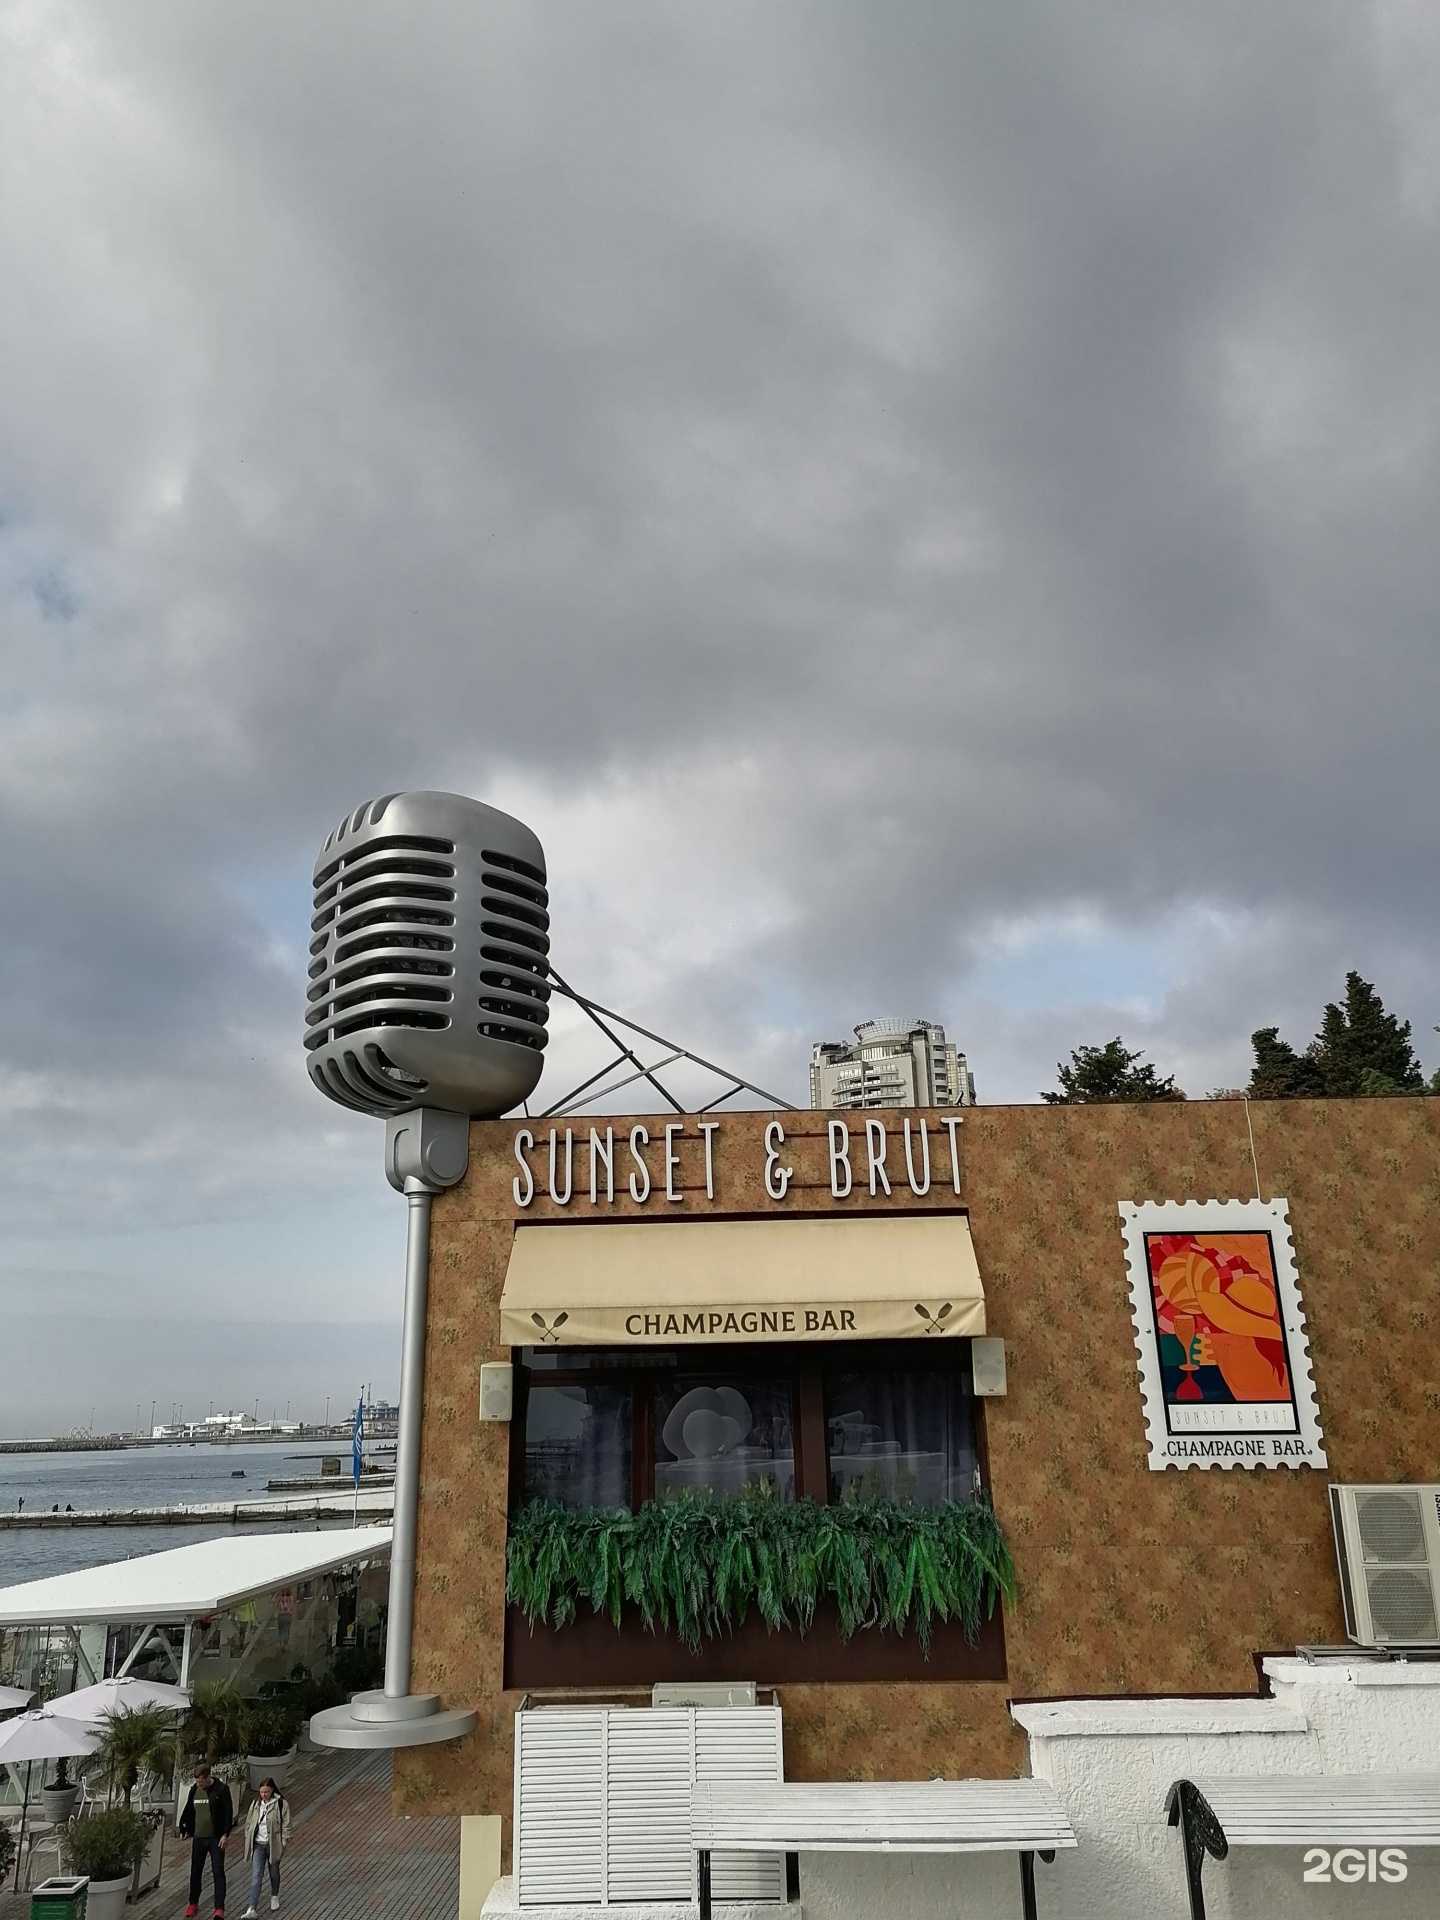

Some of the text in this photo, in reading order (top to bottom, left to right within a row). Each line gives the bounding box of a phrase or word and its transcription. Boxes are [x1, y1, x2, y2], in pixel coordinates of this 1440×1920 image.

[512, 1117, 964, 1208] SUNSET & BRUT
[625, 1309, 857, 1336] CHAMPAGNE BAR
[1167, 1440, 1306, 1457] CHAMPAGNE BAR
